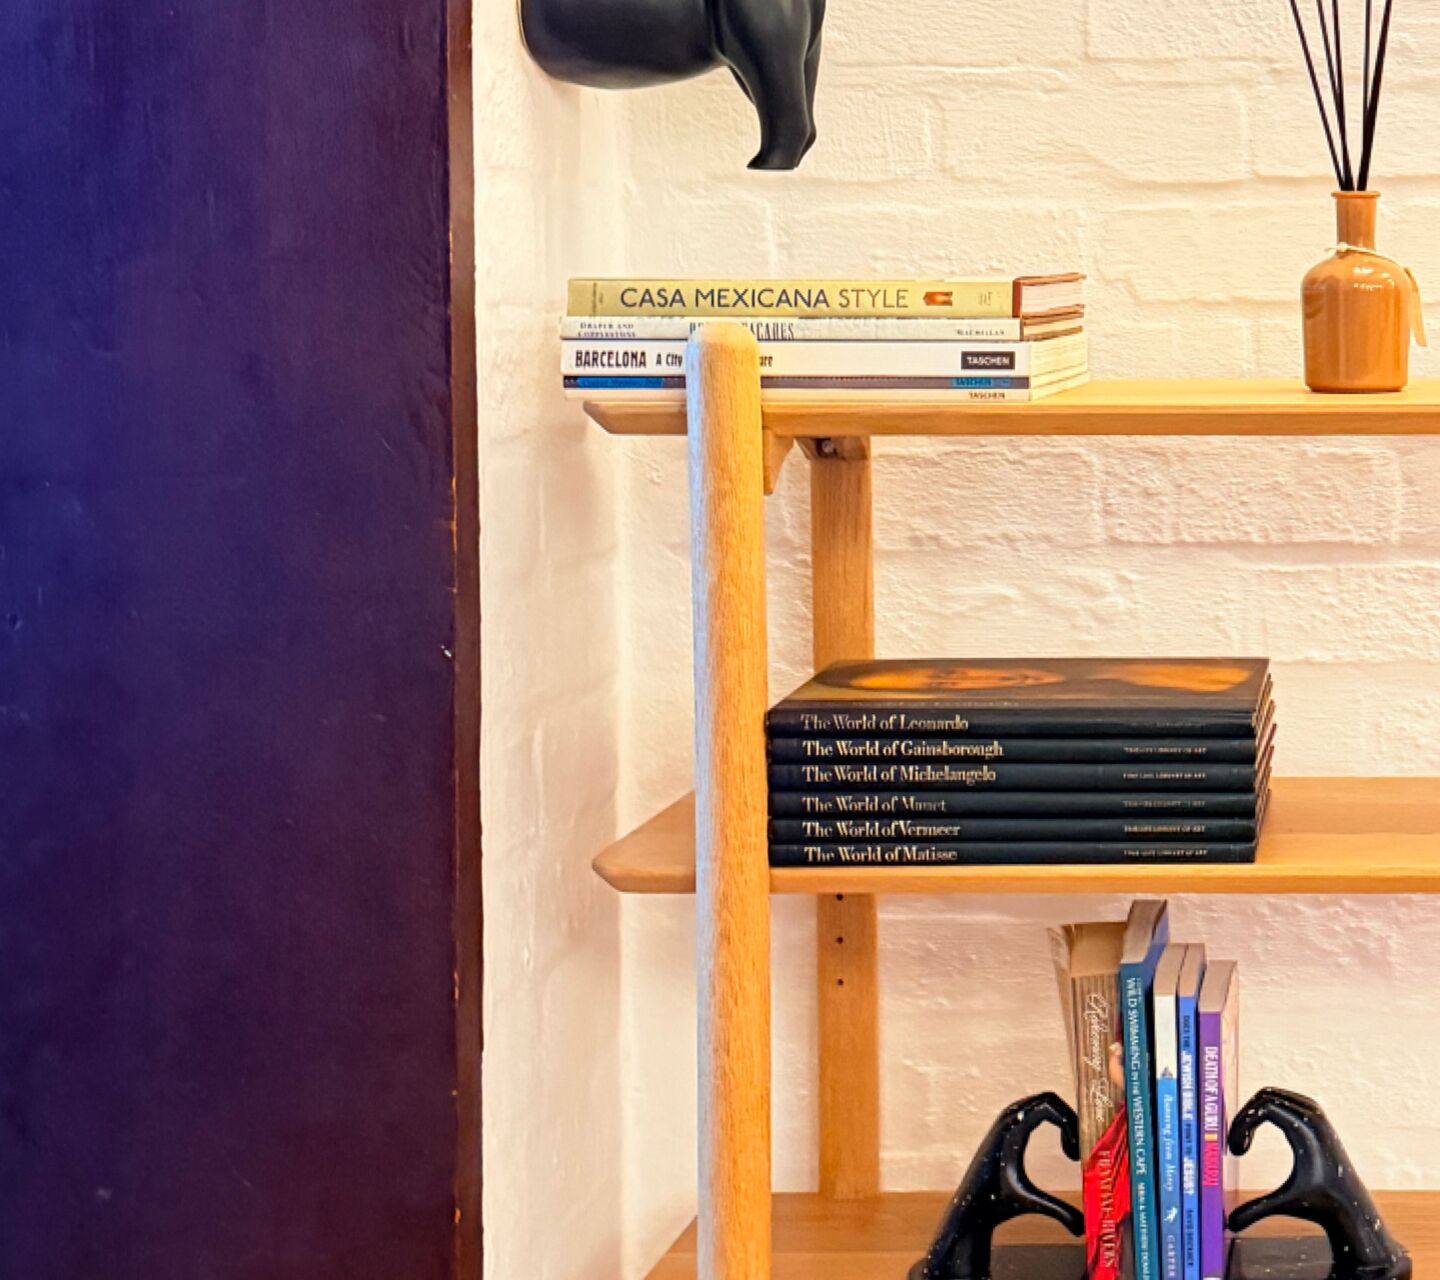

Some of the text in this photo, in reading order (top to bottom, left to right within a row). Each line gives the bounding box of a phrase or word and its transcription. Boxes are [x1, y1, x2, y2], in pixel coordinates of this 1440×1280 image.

[620, 288, 686, 308] CASA
[695, 288, 830, 308] MEXICANA
[838, 289, 909, 309] STYLE
[575, 351, 647, 368] BARCELONA
[656, 353, 662, 365] A
[966, 356, 1010, 366] TASCHEN
[968, 392, 1006, 400] TASCHEN
[800, 714, 968, 730] The World of Leonardo
[803, 740, 1004, 760] The World of Gainsborough
[802, 765, 997, 786] The World of Michelangelo
[802, 796, 832, 812] The
[835, 796, 878, 812] World
[881, 796, 898, 812] of
[802, 821, 961, 837] The World of Vermeer
[804, 846, 958, 862] The World of Matisse
[1126, 977, 1138, 1007] WILD
[1128, 1009, 1140, 1070] SWIMMING
[1181, 1050, 1193, 1089] JEWISH
[1204, 1046, 1218, 1131] DEATH OF A GURU
[1132, 1096, 1145, 1146] WESTERN
[1162, 1136, 1175, 1160] from
[1135, 1148, 1147, 1175] CAPE
